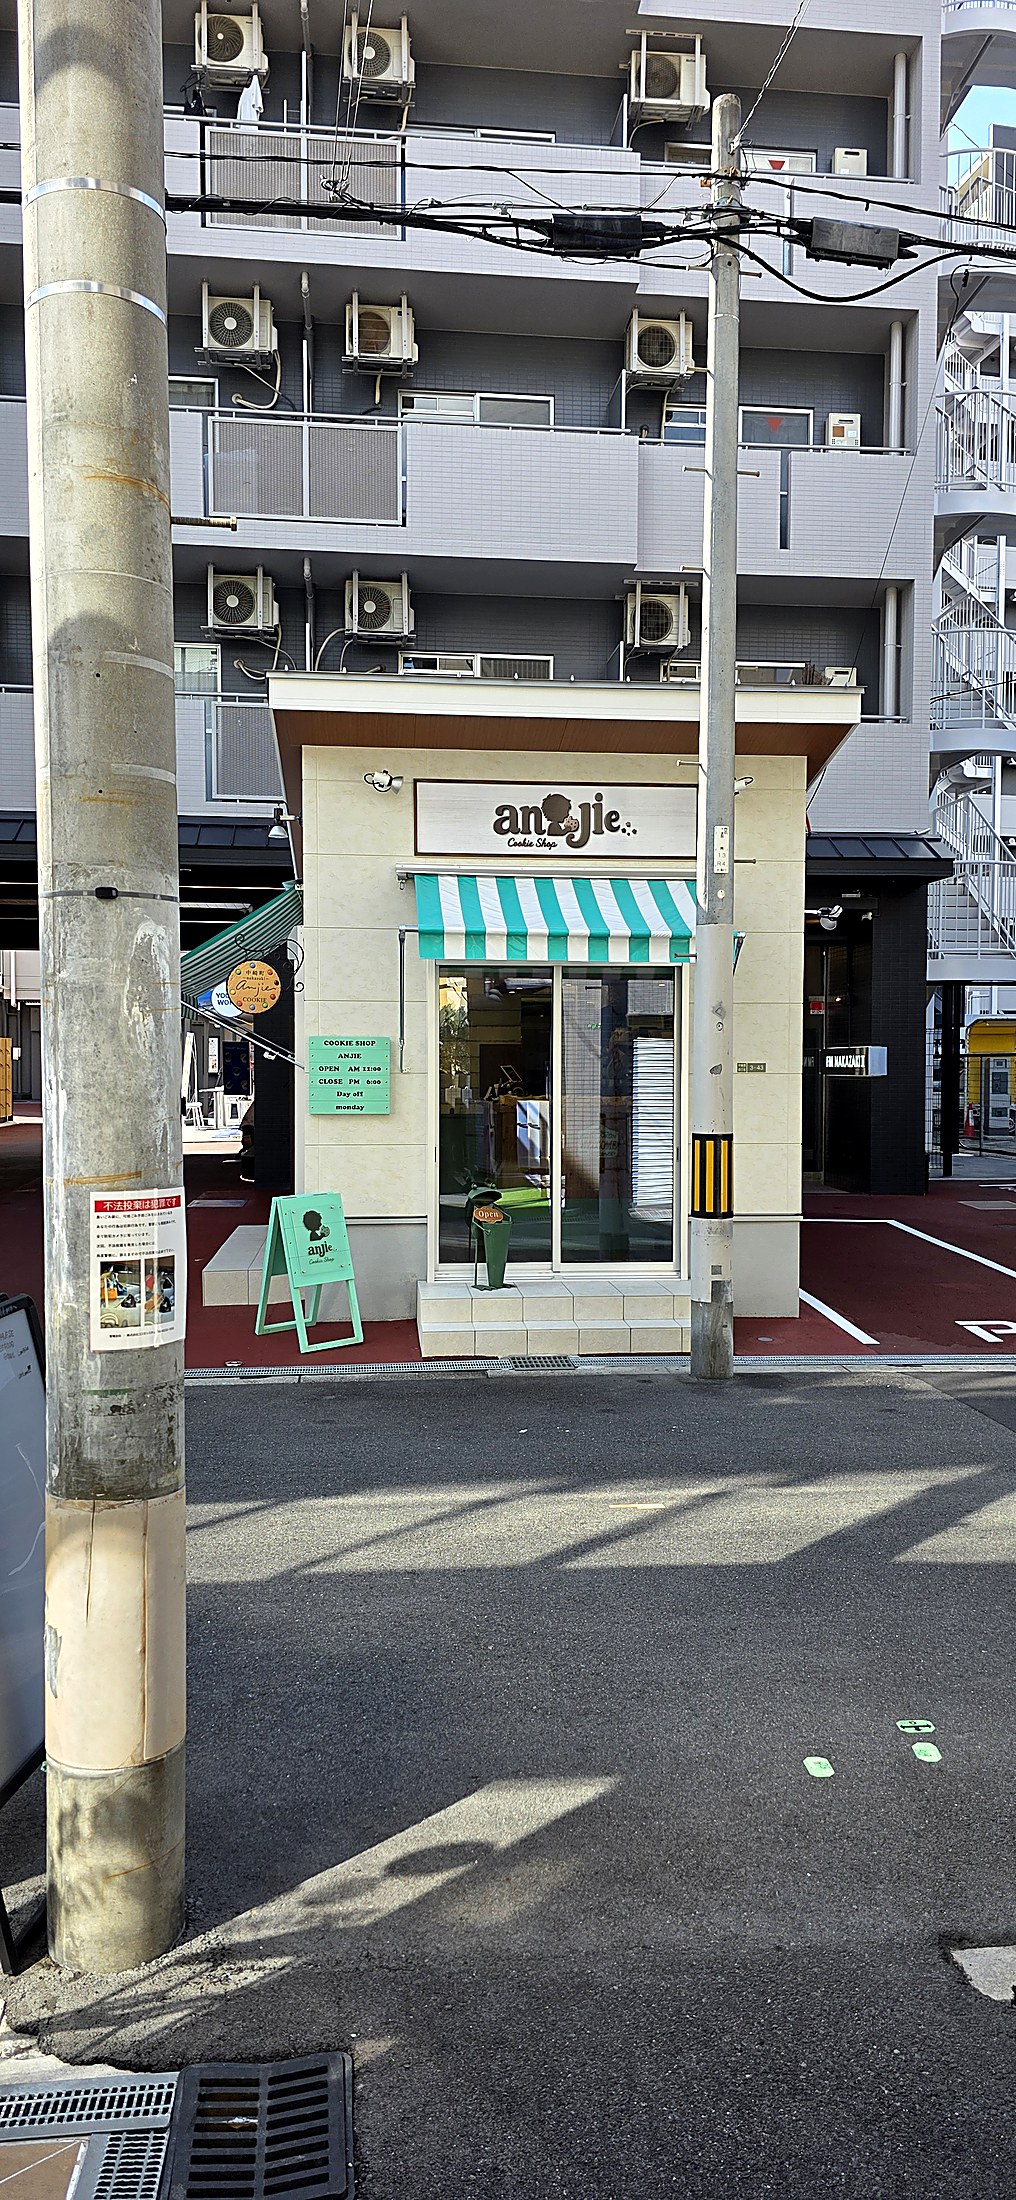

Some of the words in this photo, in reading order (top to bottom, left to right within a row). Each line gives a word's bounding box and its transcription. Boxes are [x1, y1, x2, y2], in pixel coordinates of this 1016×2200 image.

[507, 837, 534, 848] Cookie
[535, 837, 558, 850] Shop
[478, 1210, 500, 1219] Open
